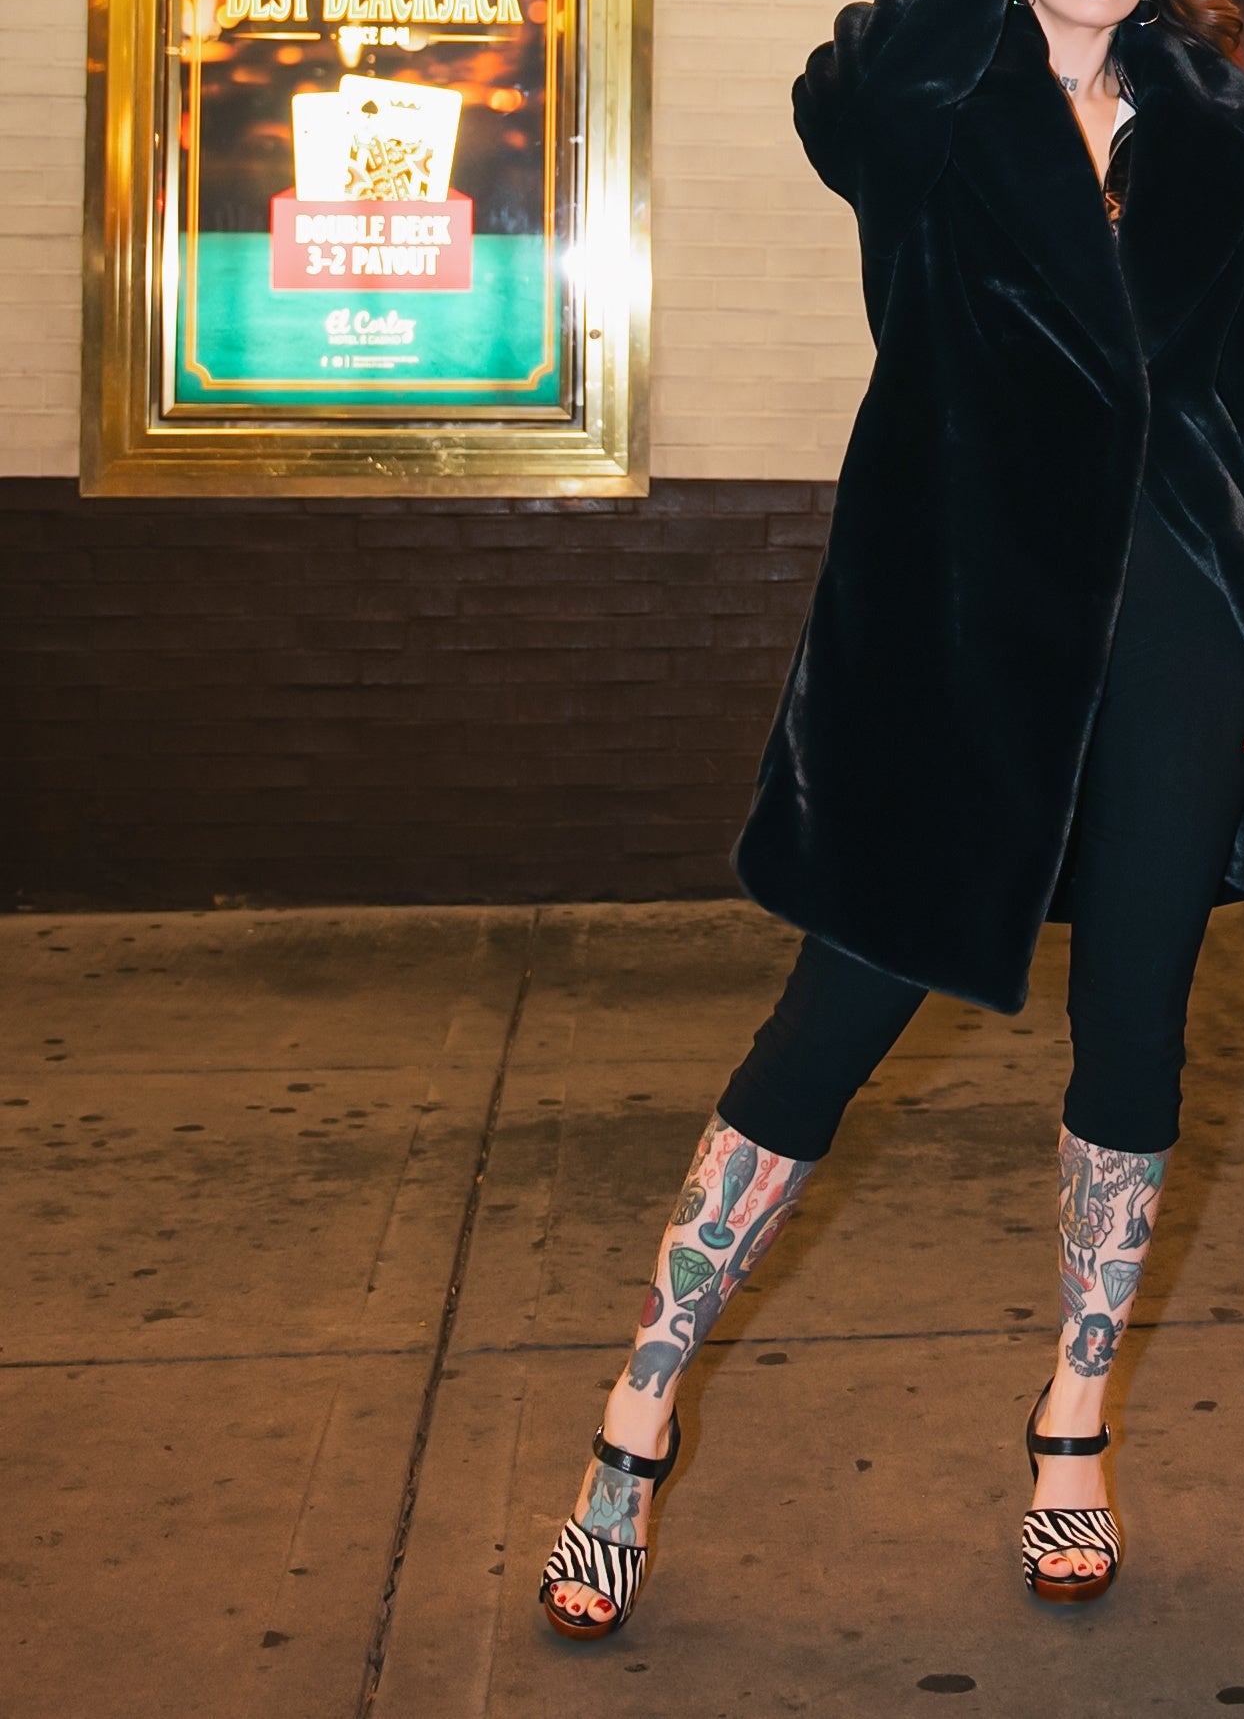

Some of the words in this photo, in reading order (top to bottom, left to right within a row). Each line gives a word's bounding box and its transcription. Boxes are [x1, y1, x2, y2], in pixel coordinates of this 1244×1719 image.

[295, 214, 386, 244] DOUBLE
[391, 215, 451, 245] DECK
[306, 245, 347, 275] 3-2
[352, 246, 440, 276] PAYOUT
